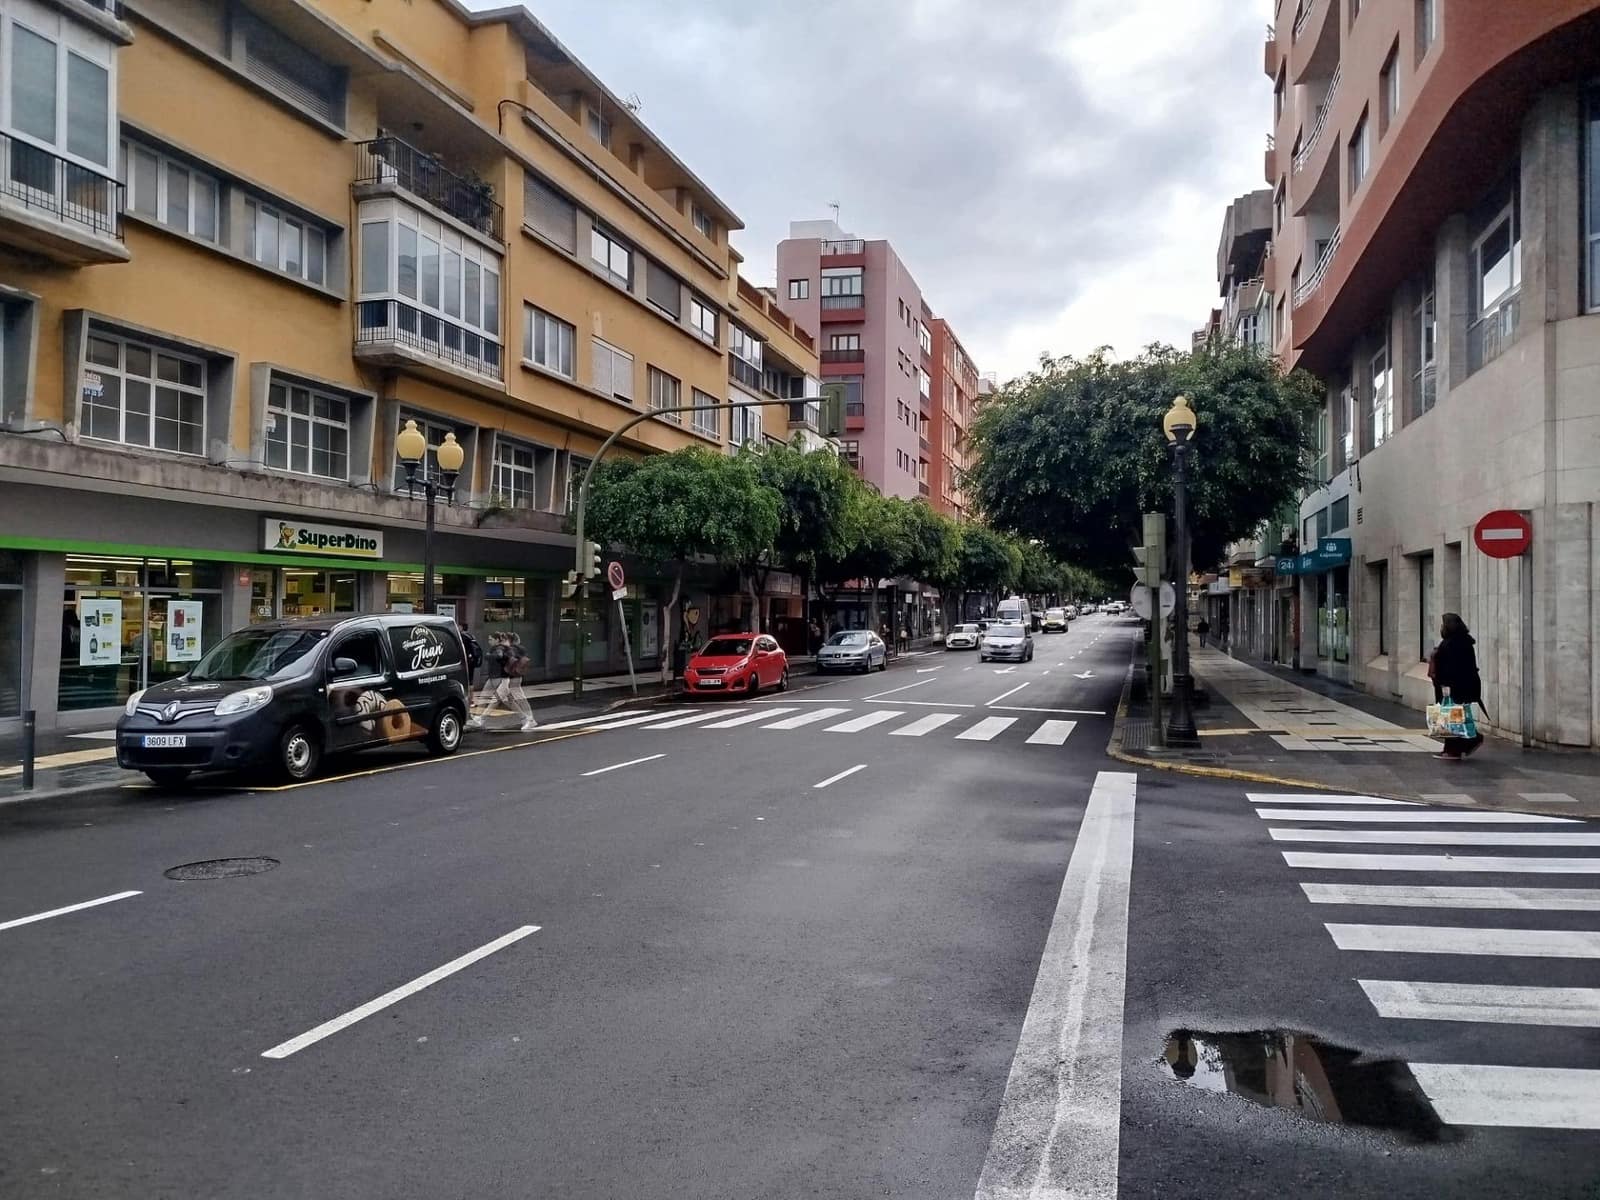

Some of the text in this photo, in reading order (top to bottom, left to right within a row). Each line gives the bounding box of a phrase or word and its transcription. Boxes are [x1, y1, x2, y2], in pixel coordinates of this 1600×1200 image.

[297, 529, 377, 550] SuperDino
[1280, 561, 1292, 570] 24
[412, 643, 444, 670] Juan
[146, 736, 185, 746] 3609 LFX
